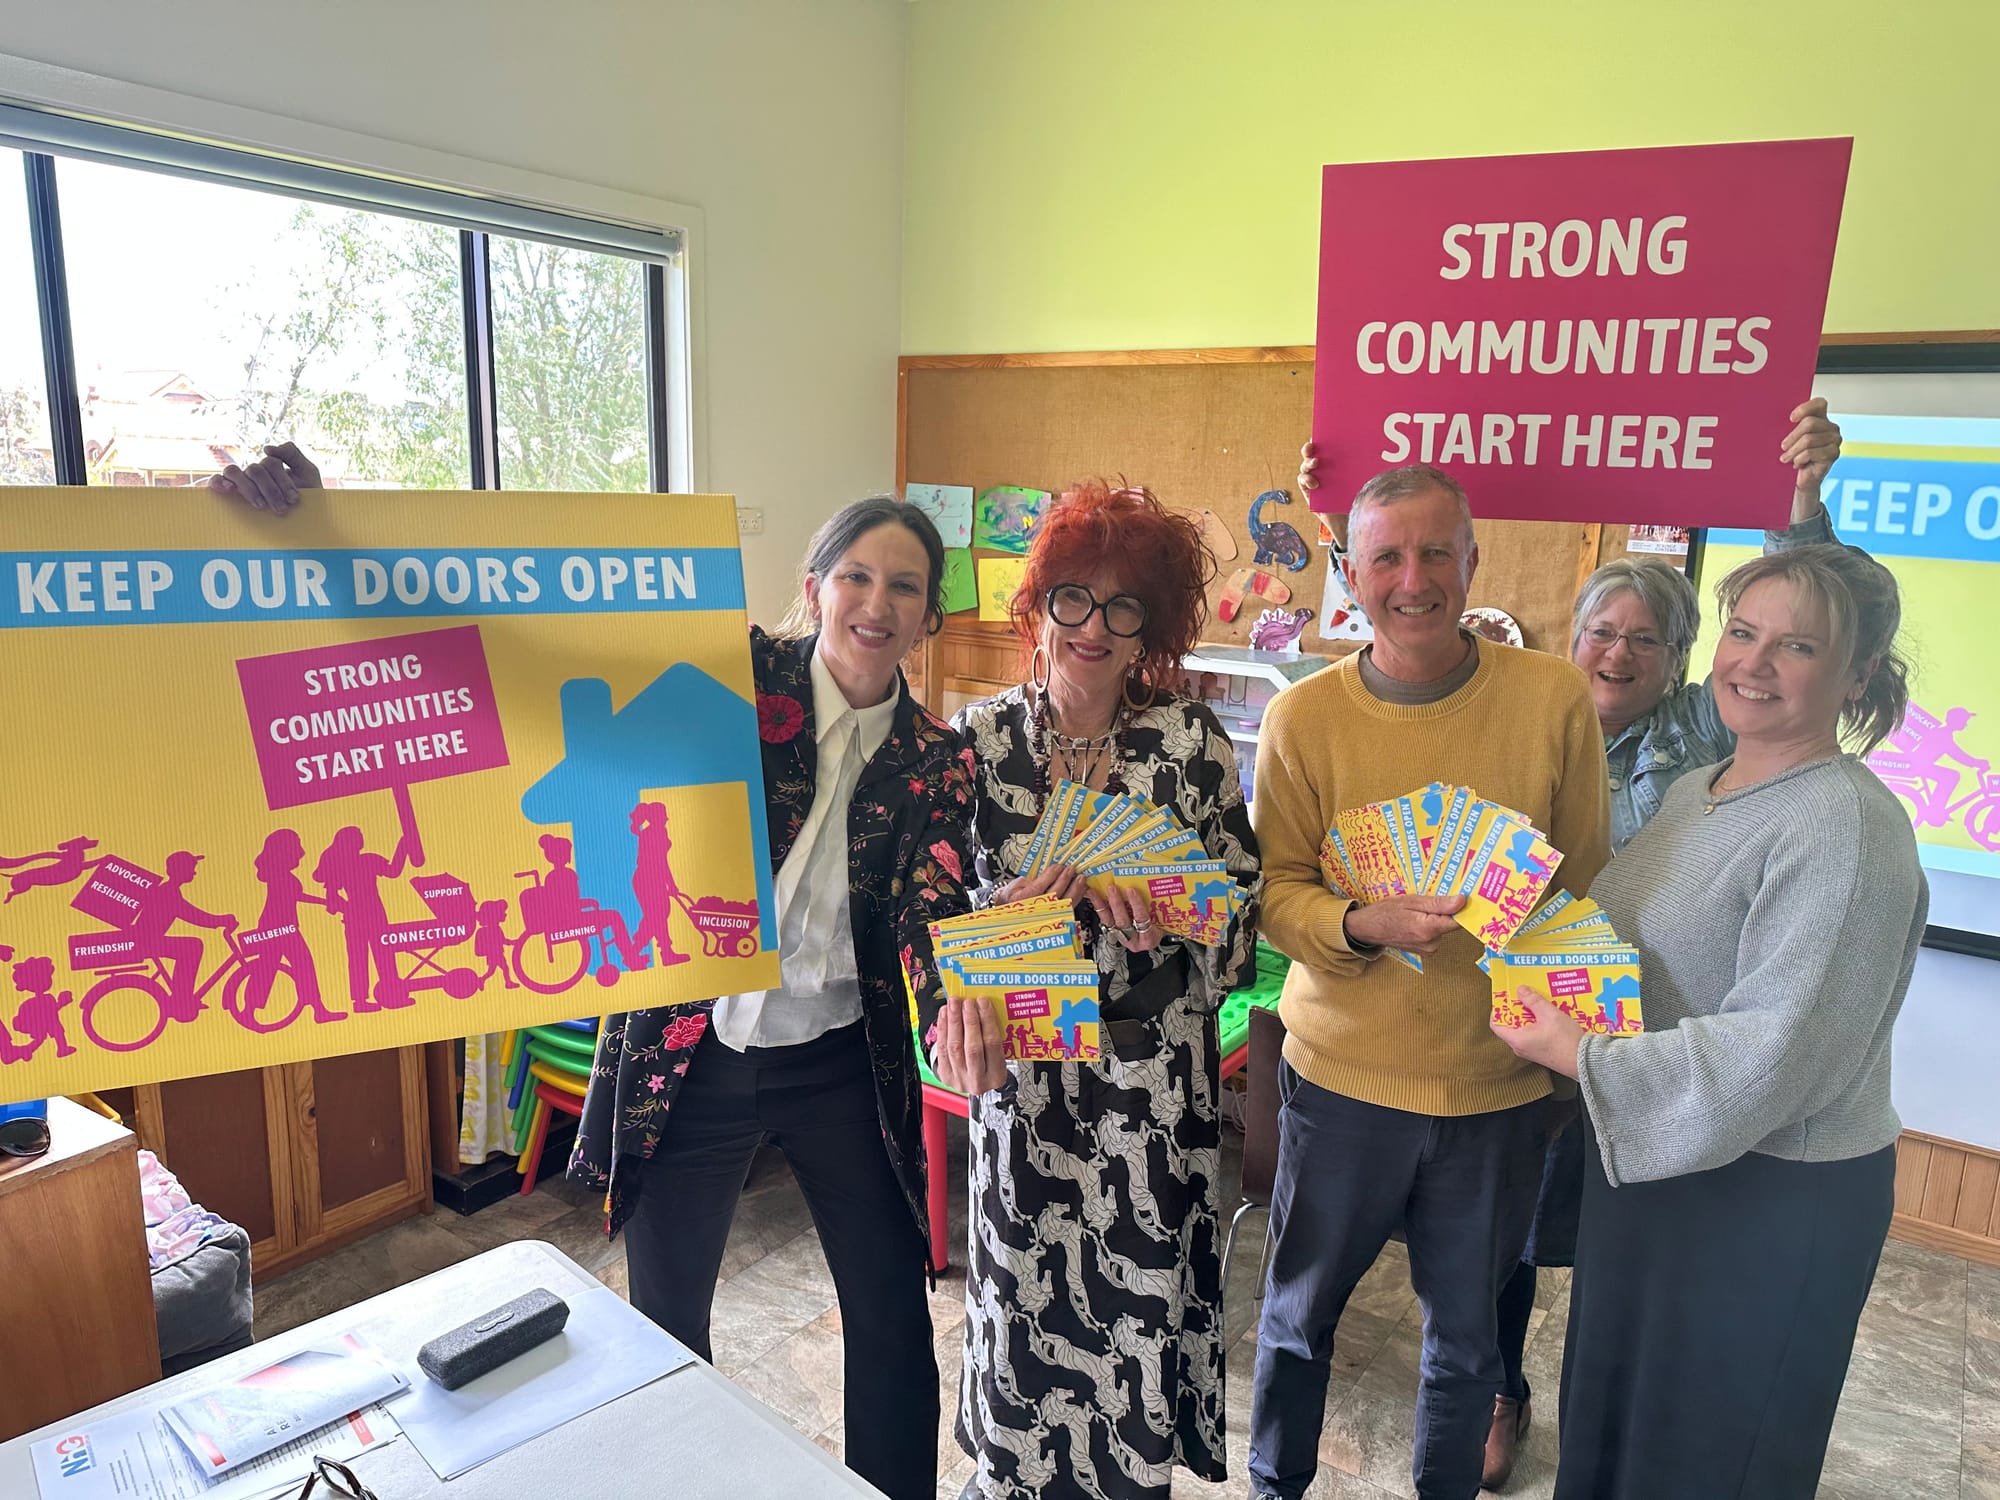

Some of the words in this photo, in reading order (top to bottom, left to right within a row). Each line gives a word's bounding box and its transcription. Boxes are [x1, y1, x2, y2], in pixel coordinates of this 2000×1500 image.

[1440, 216, 1688, 280] STRONG
[1356, 317, 1771, 374] COMMUNITIES
[1381, 412, 1551, 465] START
[1561, 414, 1719, 470] HERE
[16, 561, 173, 613] KEEP
[201, 559, 331, 609] OUR
[352, 556, 540, 605] DOORS
[561, 556, 696, 601] OPEN
[304, 654, 422, 695] STRONG
[270, 687, 473, 744] COMMUNITIES
[296, 743, 384, 783] START
[395, 730, 467, 765] HERE
[1059, 817, 1075, 843] DOORS
[1070, 794, 1083, 815] OPEN
[1088, 820, 1109, 841] DOORS
[1108, 802, 1125, 820] OPEN
[1386, 810, 1397, 833] OPEN
[1401, 803, 1412, 826] OPEN
[1439, 821, 1456, 848] DOORS
[1449, 796, 1465, 819] OPEN
[1097, 828, 1120, 850] DOORS
[1118, 812, 1137, 830] OPEN
[1145, 824, 1167, 840] OPEN
[1406, 829, 1418, 857] DOORS
[1021, 854, 1034, 872] KEEP
[1030, 836, 1042, 852] OUR
[1096, 860, 1116, 873] KEEP
[1166, 832, 1190, 847] OPEN
[1334, 835, 1346, 856] OPEN
[1438, 883, 1449, 896] EEP
[1444, 863, 1457, 881] OUR
[1452, 834, 1469, 861] DOORS
[1463, 810, 1479, 832] OPEN
[1462, 874, 1476, 891] OUR
[1471, 845, 1491, 872] DOORS
[1486, 822, 1503, 844] OPEN
[105, 862, 153, 890] ADVOCACY
[1164, 864, 1193, 872] DOORS
[1412, 860, 1423, 879] OUR
[90, 881, 140, 910] RESILIENCE
[424, 887, 463, 899] SUPPORT
[699, 916, 750, 929] INCLUSION
[1518, 914, 1545, 937] DOORS
[1544, 895, 1566, 916] OPEN
[243, 925, 297, 945] WELLBEING
[380, 925, 466, 945] CONNECTION
[550, 926, 596, 941] LEEARNING
[974, 948, 995, 960] OUR
[998, 941, 1033, 956] DOORS
[1036, 935, 1064, 949] OPEN
[75, 942, 135, 956] FRIENDSHIP
[1514, 956, 1537, 965] KEEP
[1541, 955, 1562, 964] OUR
[1566, 955, 1599, 964] DOORS
[1602, 954, 1630, 963] OPEN
[971, 974, 995, 984] KEEP
[999, 974, 1021, 985] OUR
[1025, 974, 1059, 985] DOORS
[1063, 975, 1091, 985] OPEN
[1551, 978, 1588, 986] COMMUNITIES
[1009, 1000, 1046, 1009] COMMUNITIES
